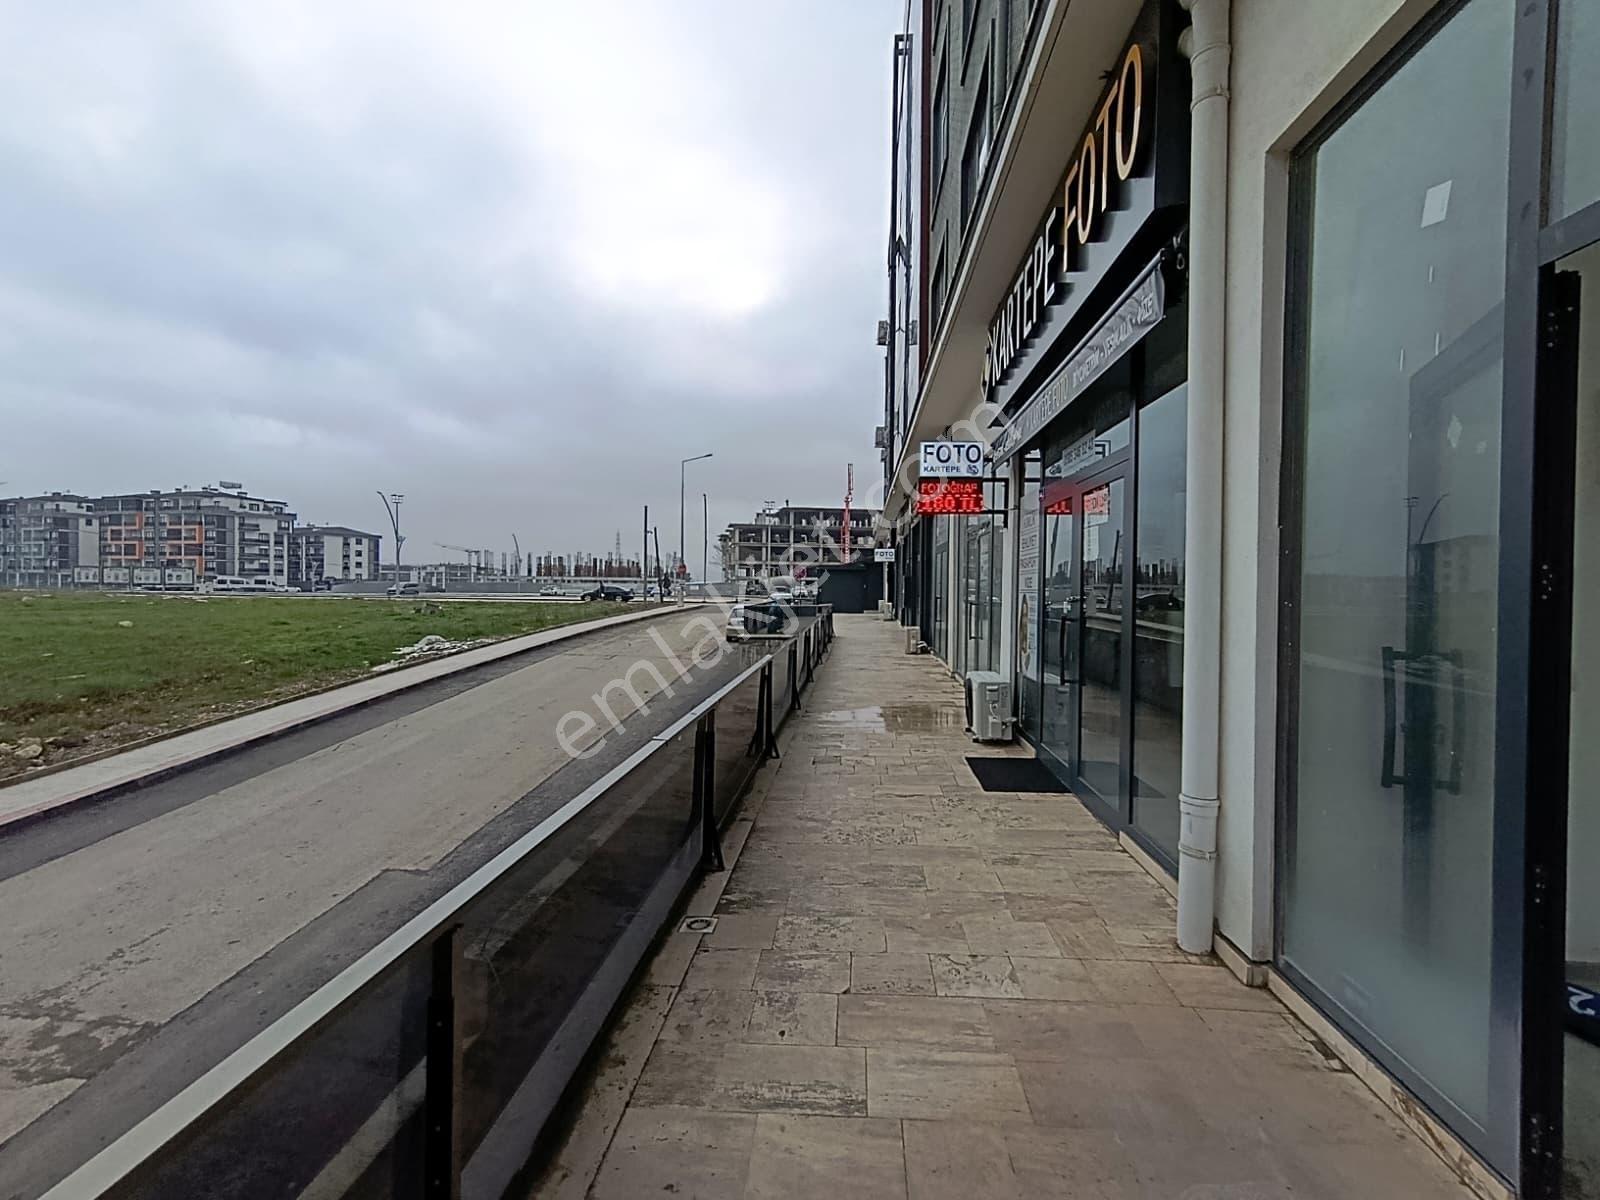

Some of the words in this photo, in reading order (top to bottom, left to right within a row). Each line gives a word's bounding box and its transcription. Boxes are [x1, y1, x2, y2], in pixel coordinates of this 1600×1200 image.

[991, 207, 1056, 387] KARTEPE
[1063, 43, 1142, 273] FOTO
[923, 444, 981, 464] FOTO
[923, 465, 961, 473] KARTEPE
[921, 481, 978, 493] FOTOĞRAF
